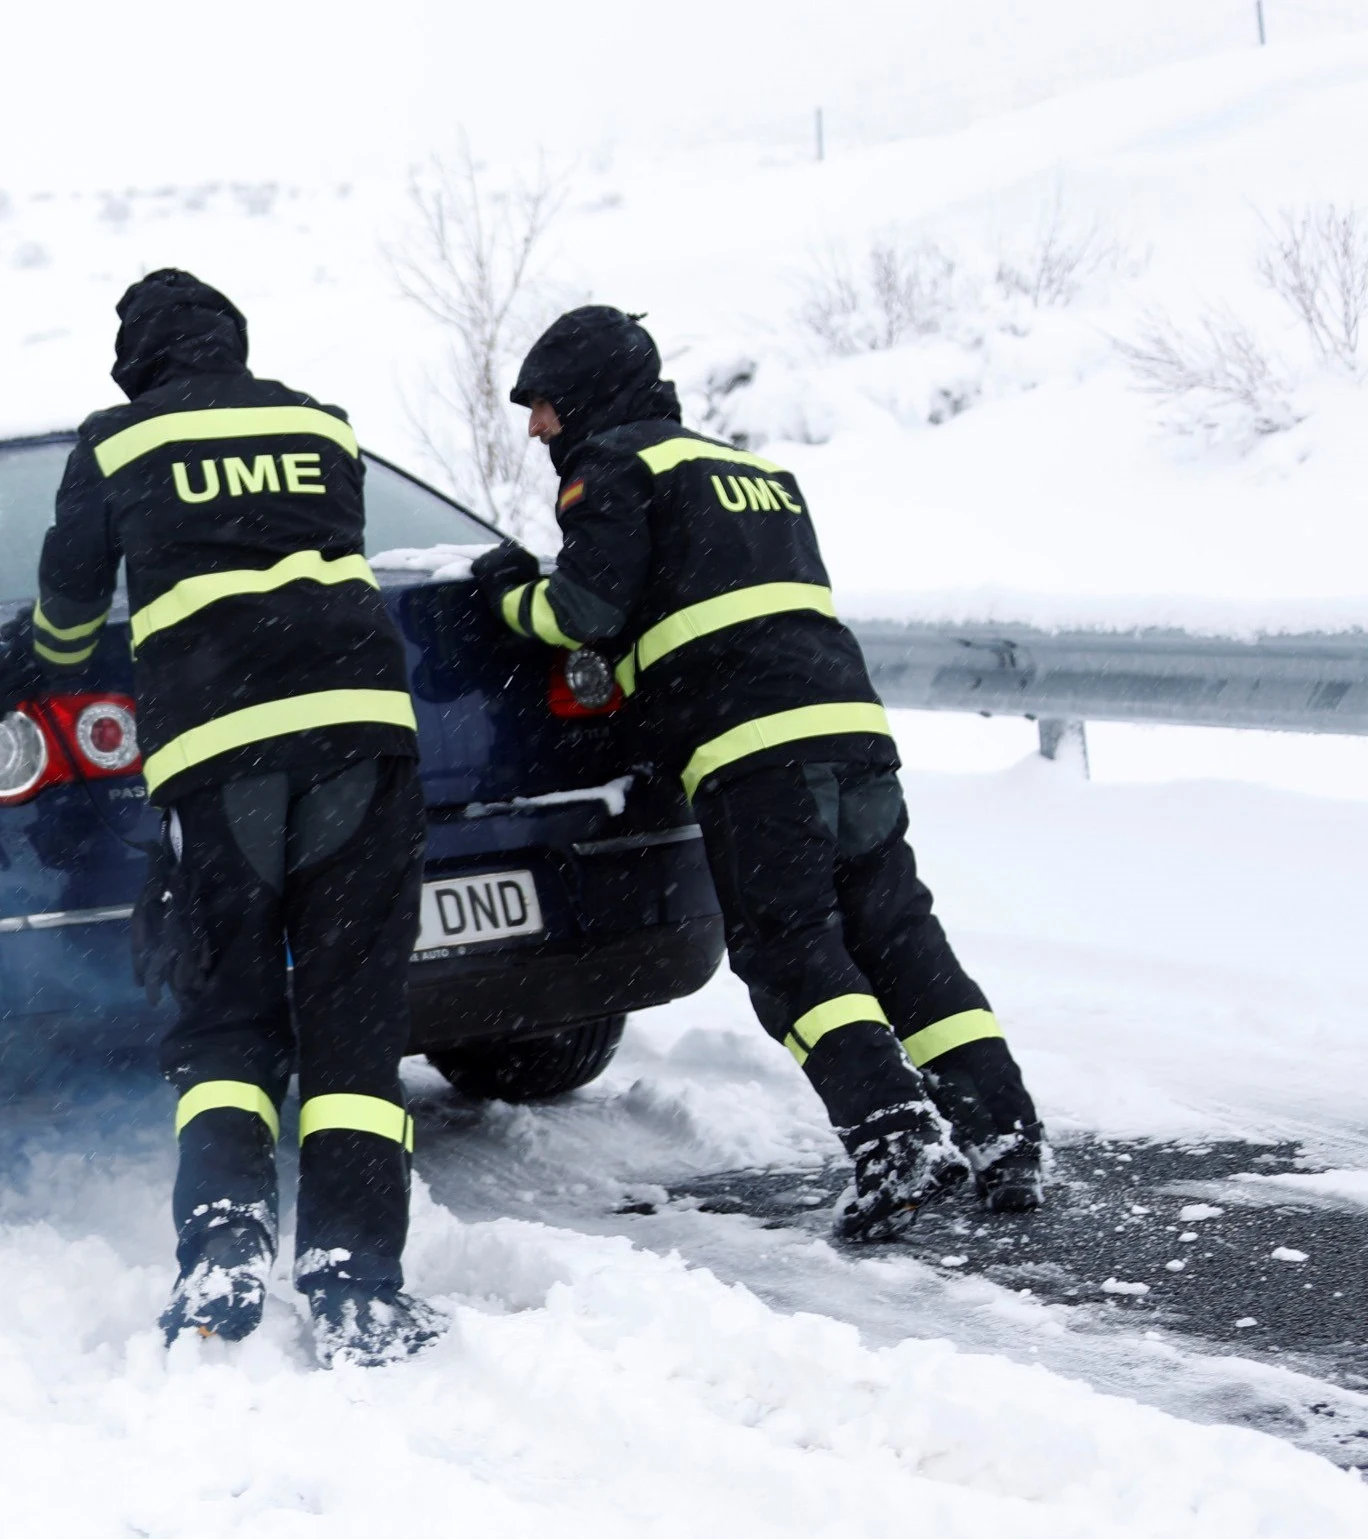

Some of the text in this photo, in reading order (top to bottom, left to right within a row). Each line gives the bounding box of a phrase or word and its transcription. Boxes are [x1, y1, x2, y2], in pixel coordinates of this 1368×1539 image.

[172, 453, 326, 503] UME
[711, 475, 801, 514] UME
[435, 880, 527, 936] DND
[422, 948, 450, 960] AUTO
